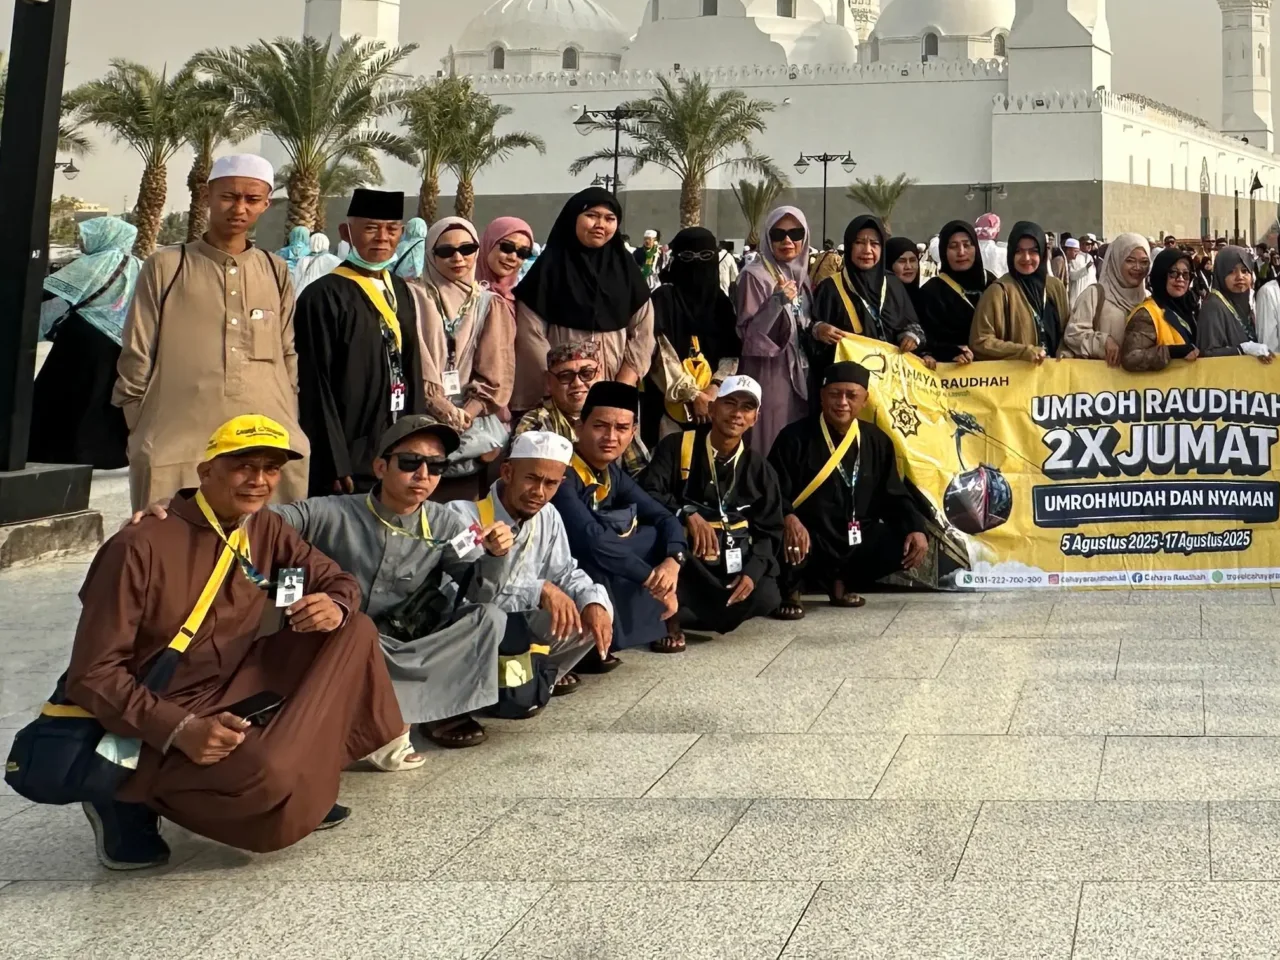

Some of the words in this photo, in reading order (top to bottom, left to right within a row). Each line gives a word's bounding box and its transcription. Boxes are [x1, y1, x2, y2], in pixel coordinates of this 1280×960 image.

[941, 376, 1009, 390] RAUDHAH
[1031, 390, 1137, 422] UMROH
[1042, 425, 1113, 471] 2X
[1115, 423, 1279, 467] JUMAT
[1169, 489, 1204, 507] DAN
[1208, 489, 1275, 508] NYAMAN
[1061, 536, 1070, 551] 5
[1072, 535, 1127, 553] Agustus
